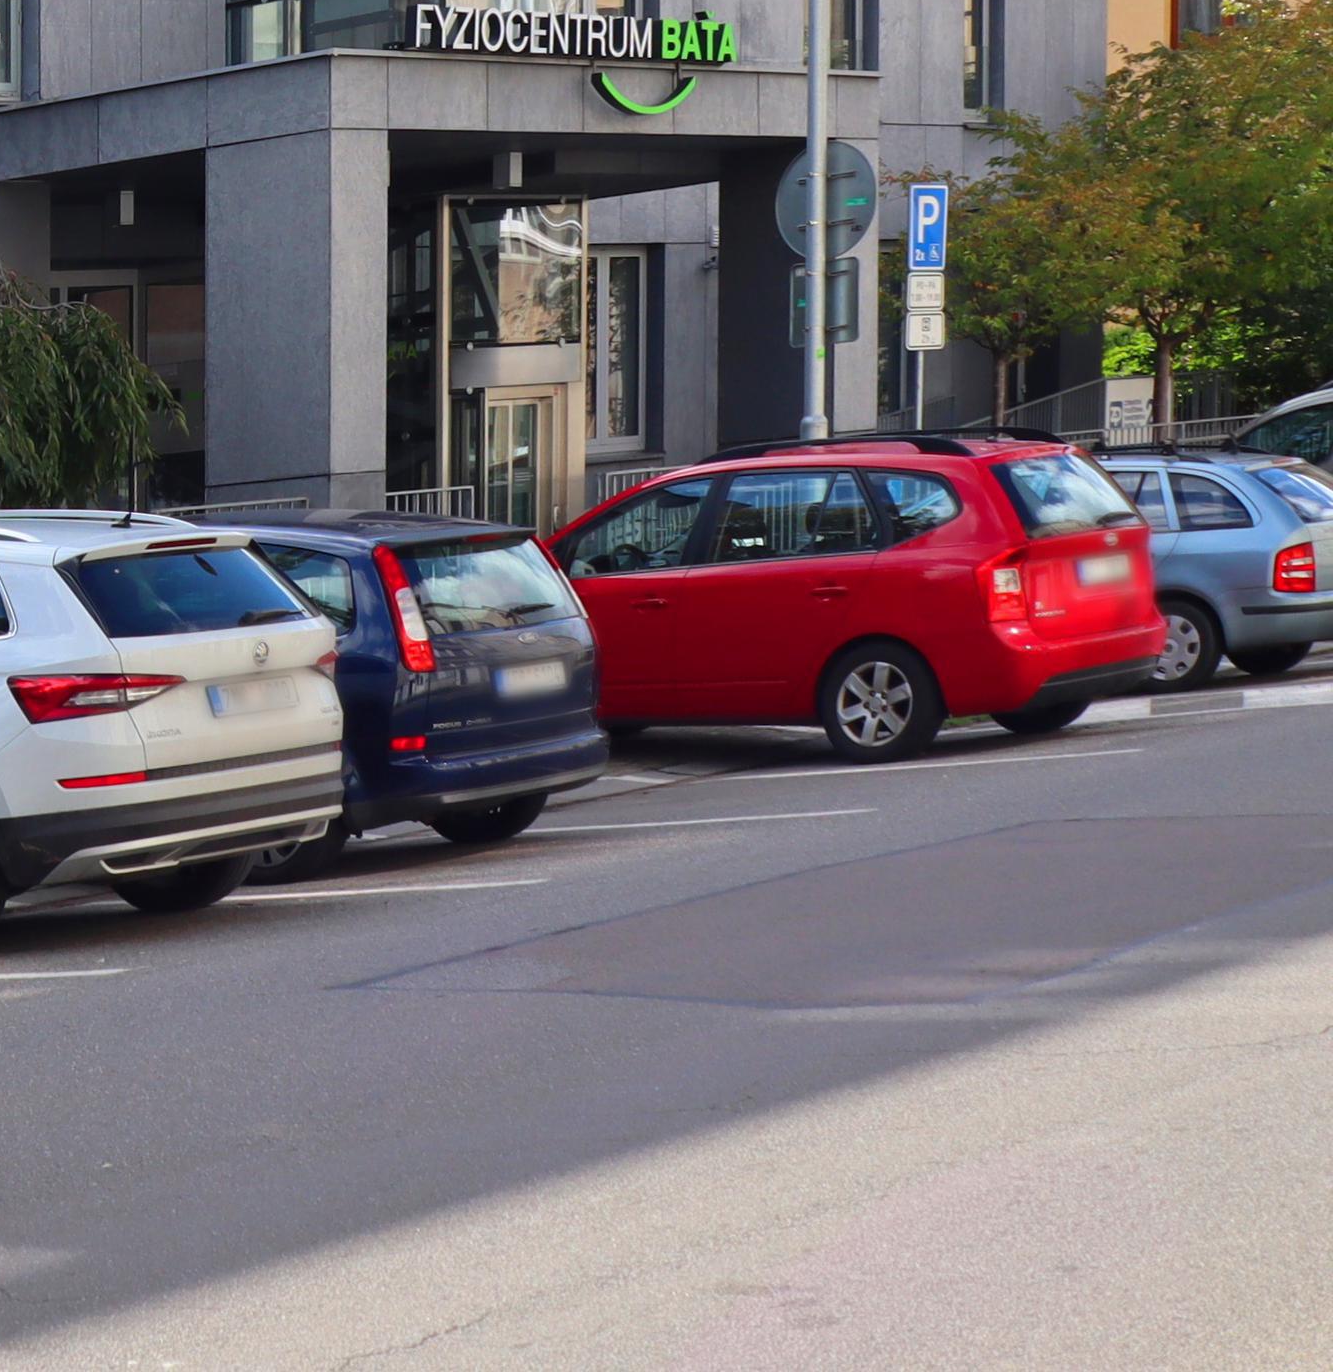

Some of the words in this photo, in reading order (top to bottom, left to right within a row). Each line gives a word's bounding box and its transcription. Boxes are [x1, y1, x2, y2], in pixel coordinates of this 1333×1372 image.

[415, 3, 652, 59] FYZIOCENTRUM
[661, 10, 738, 62] BAŤA
[917, 195, 940, 244] P
